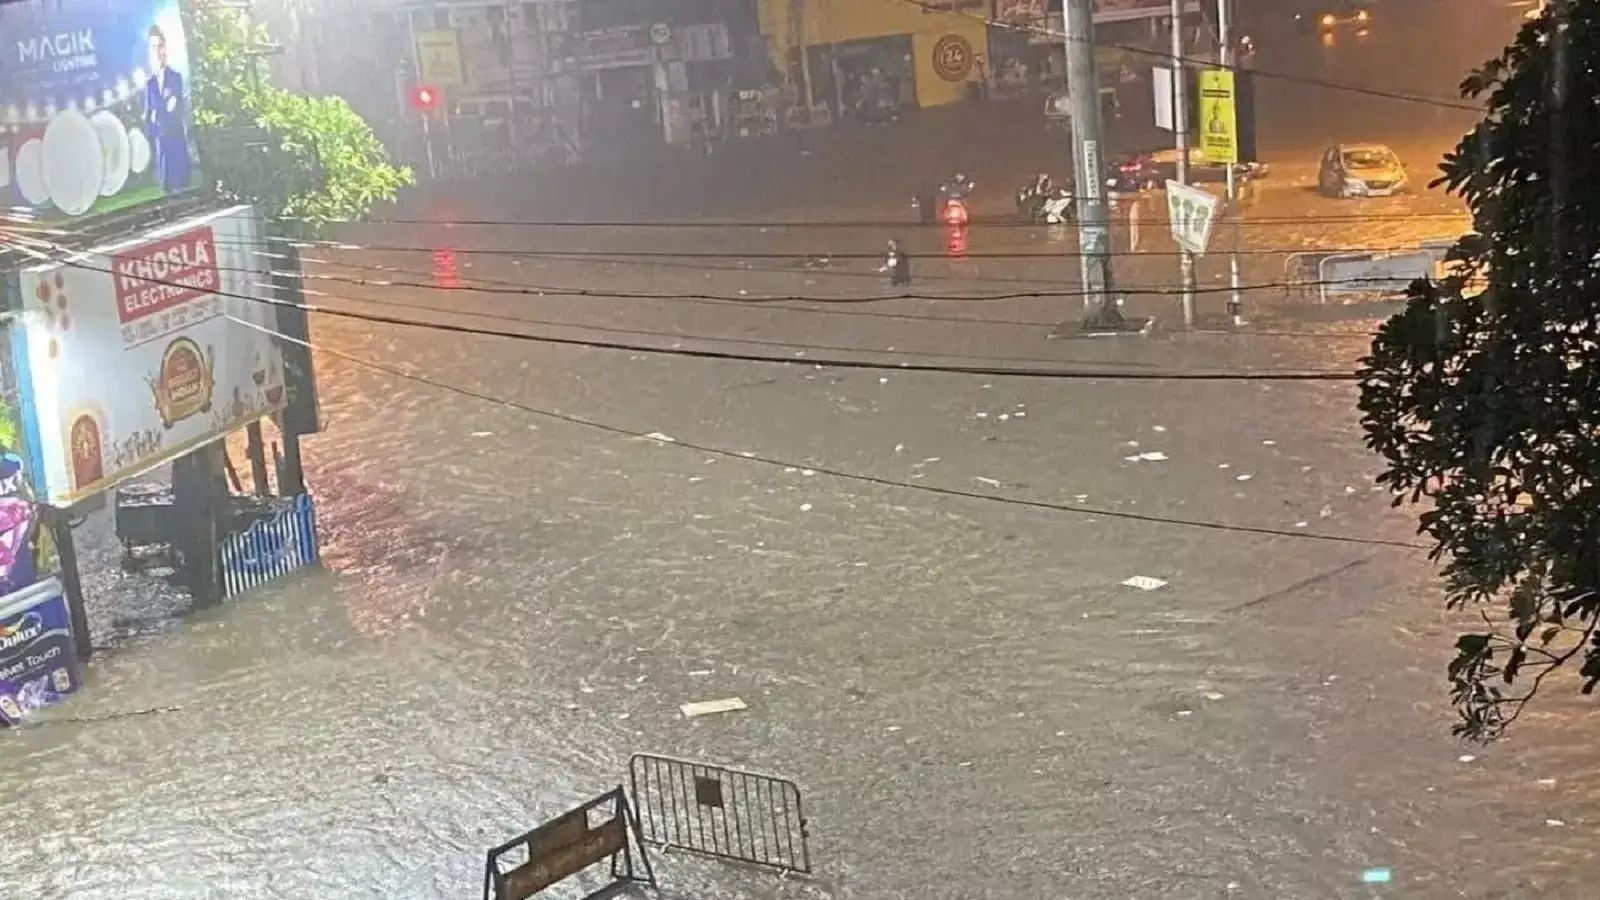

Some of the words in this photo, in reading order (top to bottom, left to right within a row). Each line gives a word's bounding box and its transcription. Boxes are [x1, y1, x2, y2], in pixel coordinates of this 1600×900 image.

[17, 29, 95, 63] MAGIK
[120, 240, 209, 291] KHOSLA
[124, 269, 214, 313] ELECTRONICS
[25, 646, 61, 667] Touch
